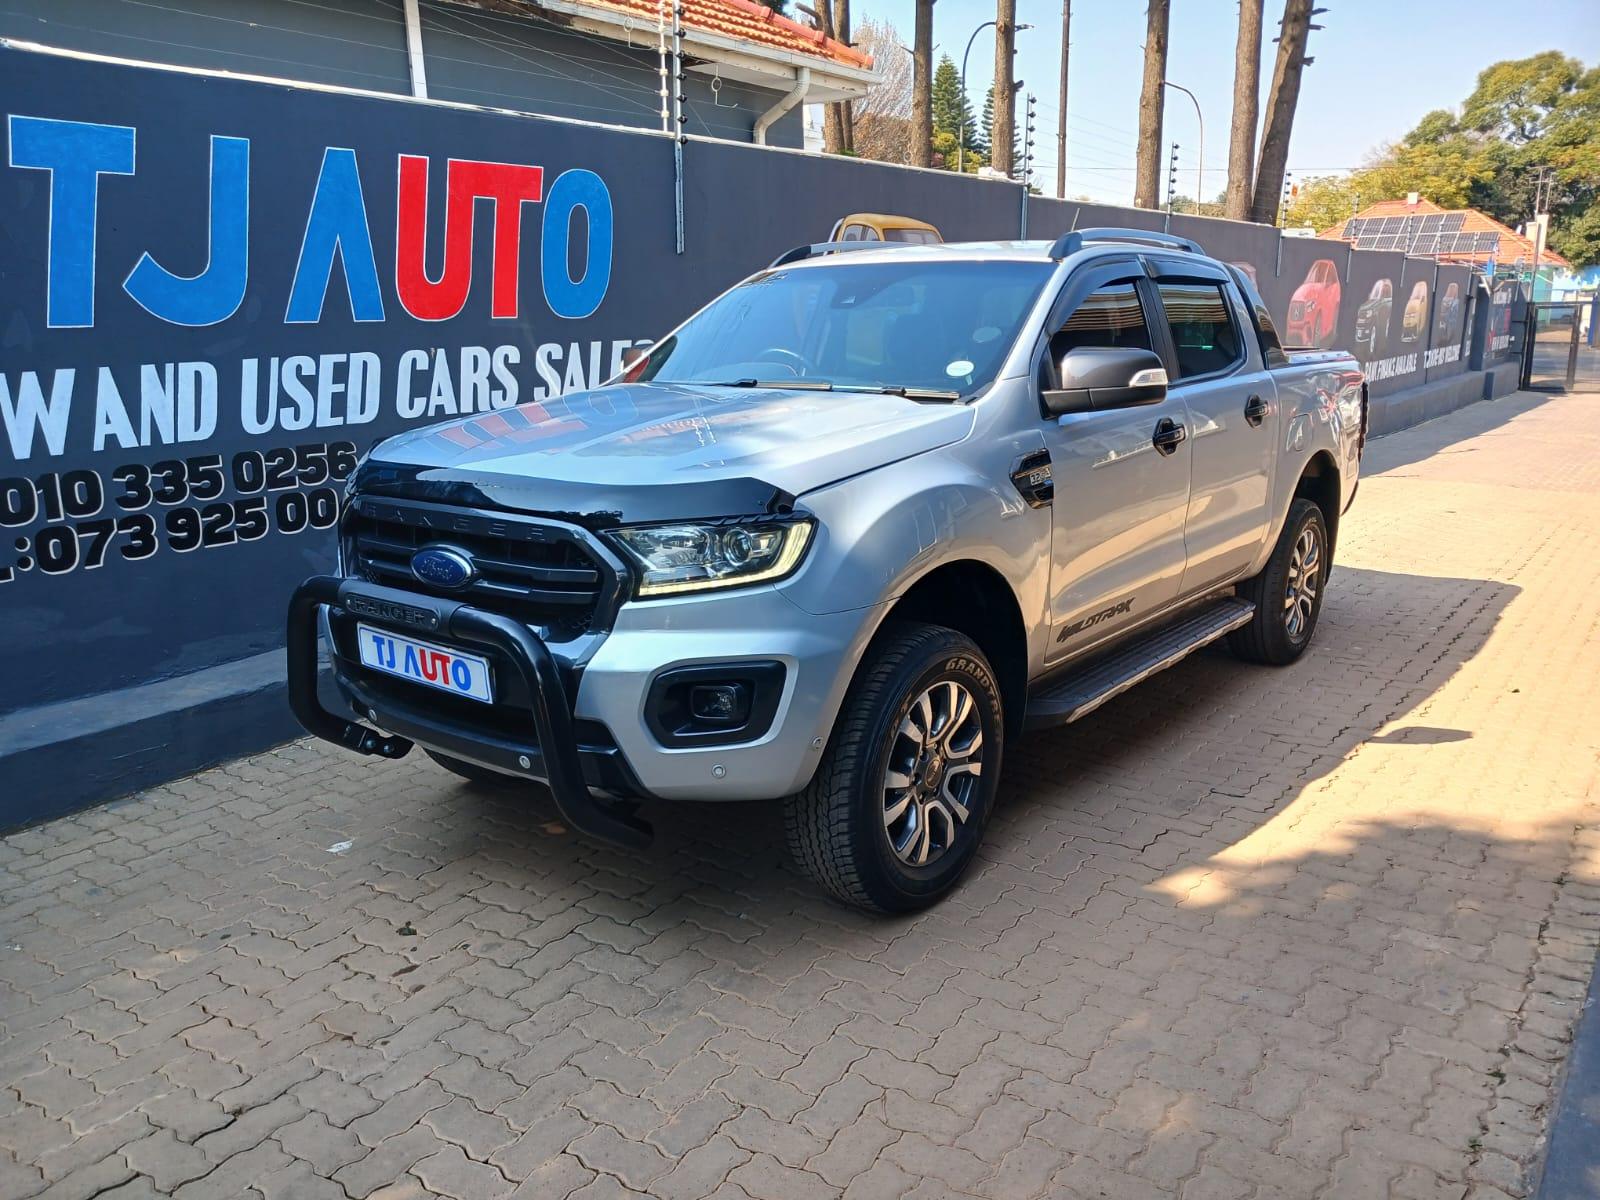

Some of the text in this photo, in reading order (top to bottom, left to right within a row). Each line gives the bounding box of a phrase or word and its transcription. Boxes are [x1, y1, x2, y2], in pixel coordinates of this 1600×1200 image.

[8, 114, 613, 329] TJ AUTO
[92, 361, 218, 451] AND
[240, 352, 381, 435] USED
[396, 345, 520, 418] CARS
[533, 339, 655, 402] SALE
[0, 441, 358, 527] 010 335 0256
[165, 497, 270, 552] 925
[276, 488, 341, 535] 00
[420, 556, 454, 581] Ford
[355, 598, 431, 626] RANGER
[372, 635, 472, 691] TJ AUTO
